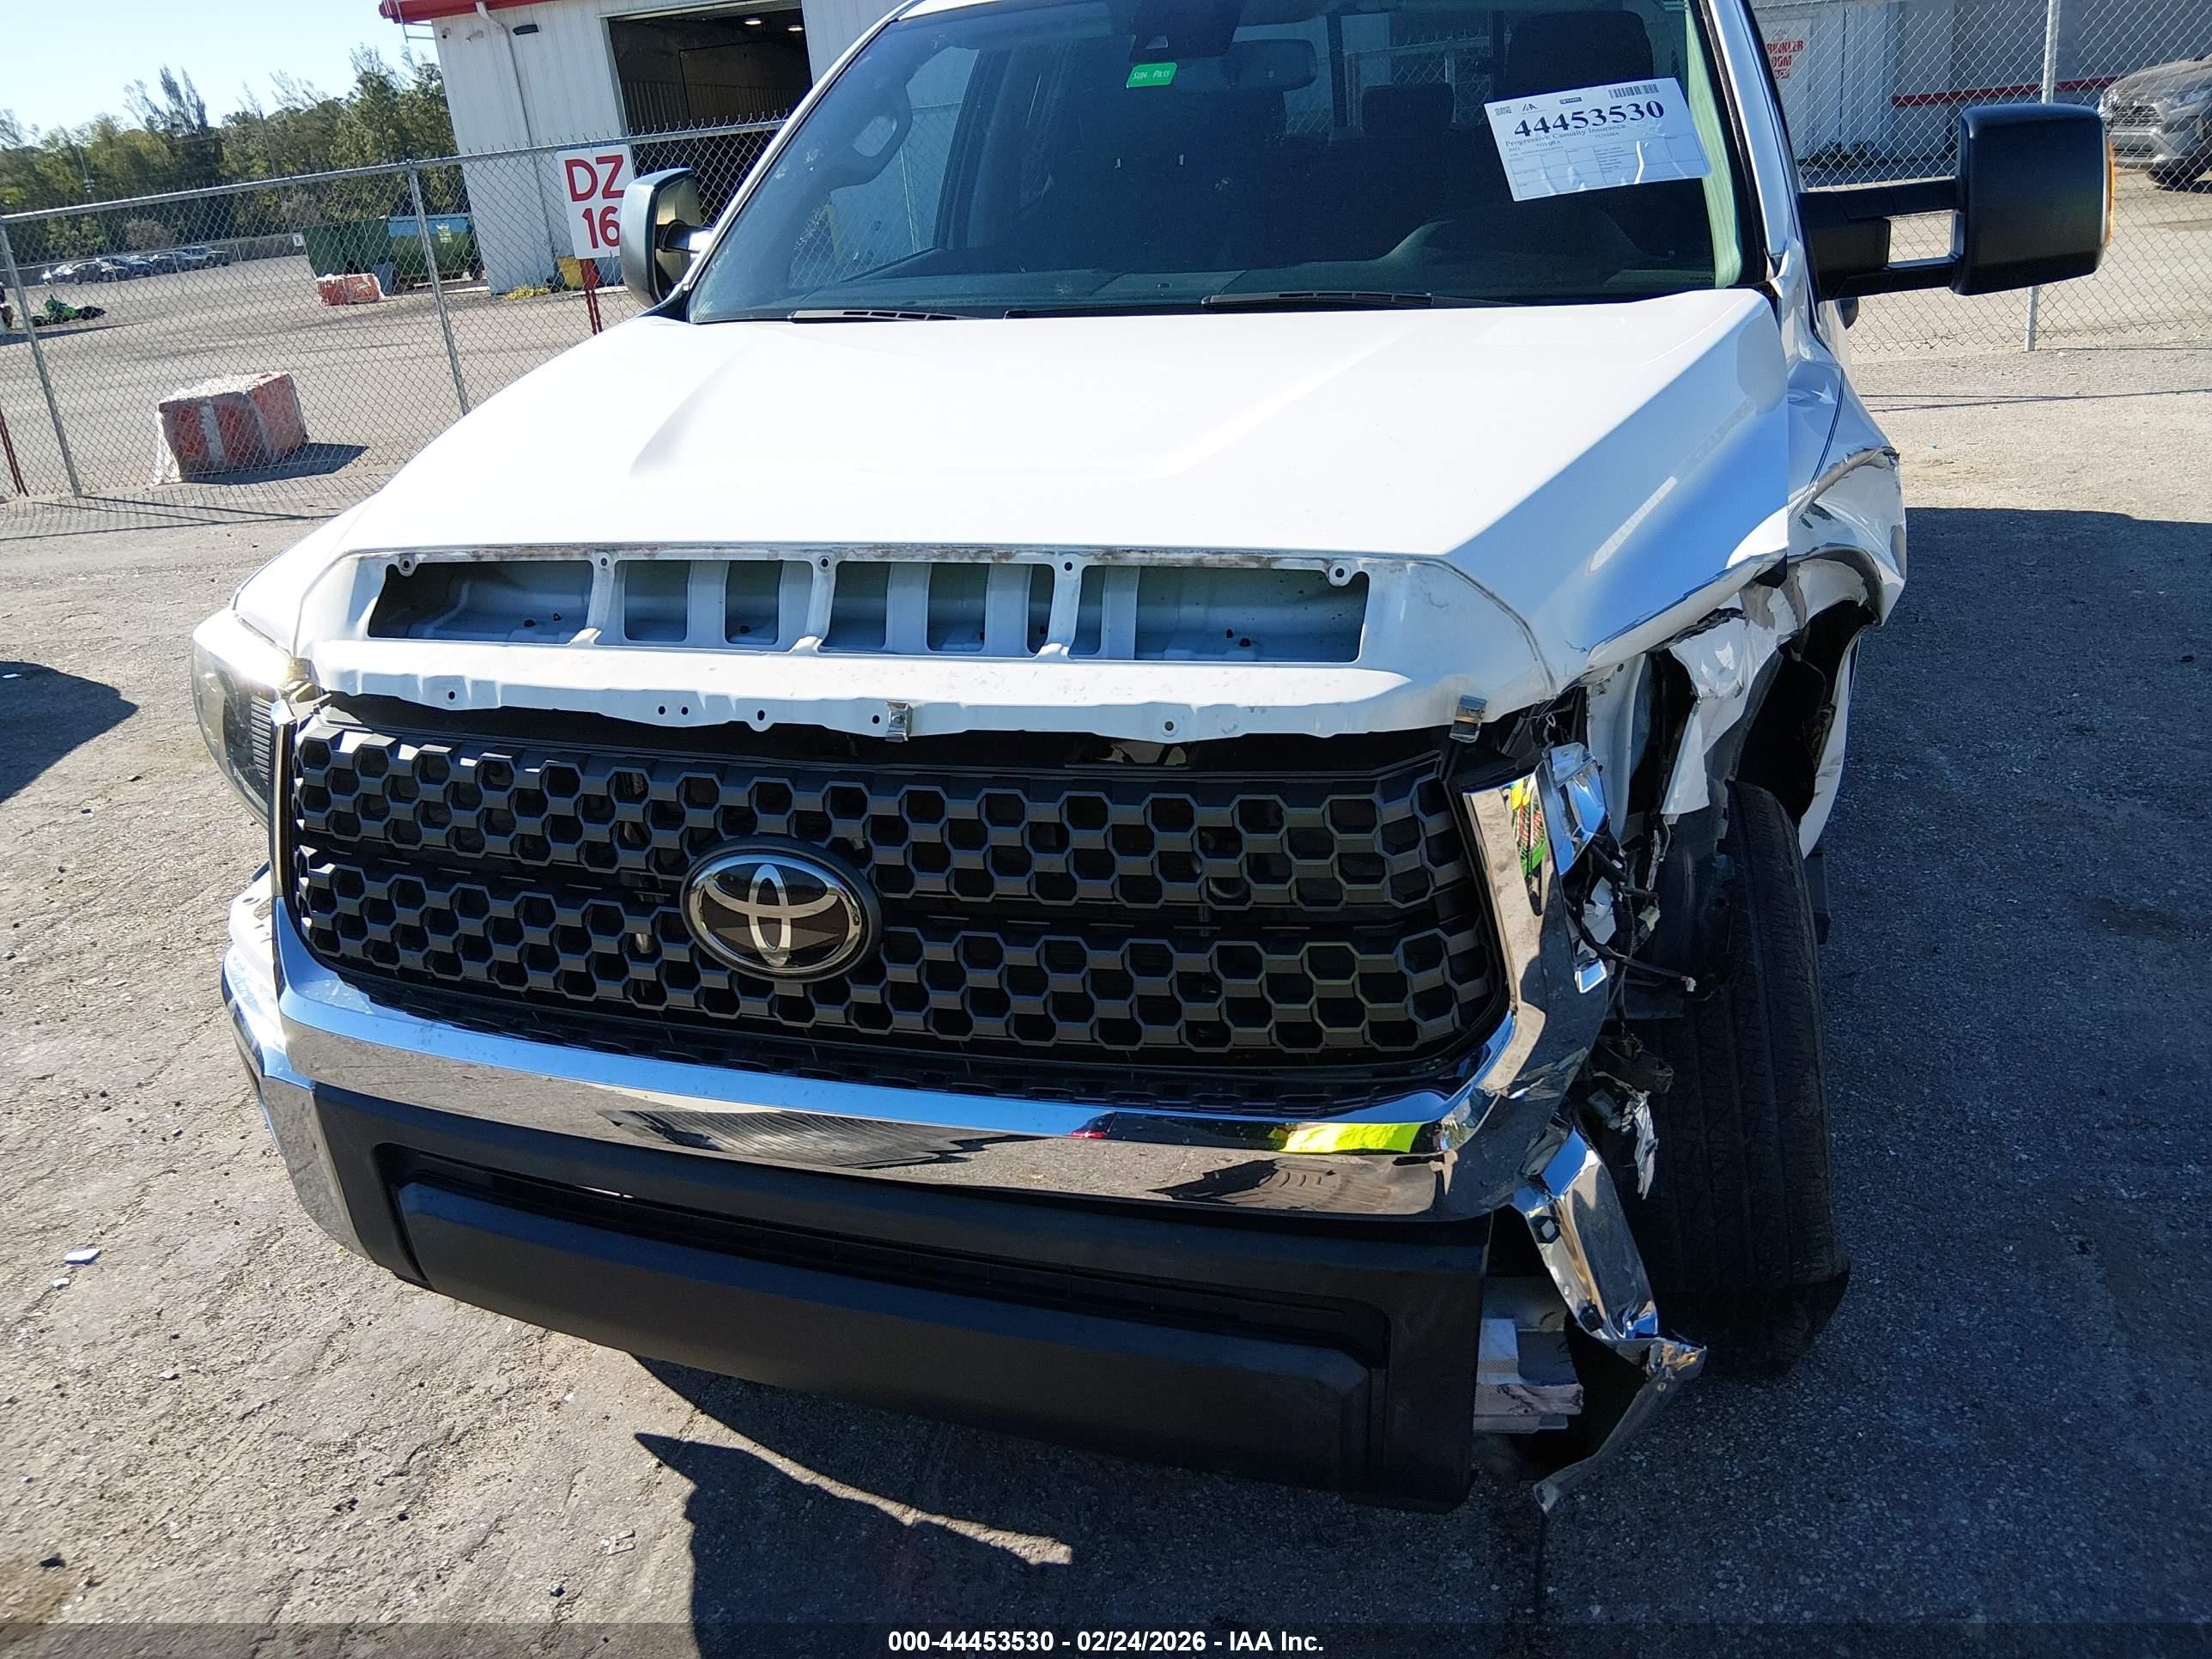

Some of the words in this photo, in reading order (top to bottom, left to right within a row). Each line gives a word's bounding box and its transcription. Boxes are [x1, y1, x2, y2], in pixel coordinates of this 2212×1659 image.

[1133, 71, 1147, 80] SUN
[1153, 70, 1170, 78] PASS
[1505, 136, 1551, 148] Progressive
[1552, 129, 1586, 138] Casualty
[1588, 124, 1627, 134] Insurance
[1514, 100, 1664, 137] 44453530
[564, 155, 625, 202] DZ
[581, 205, 619, 249] 16
